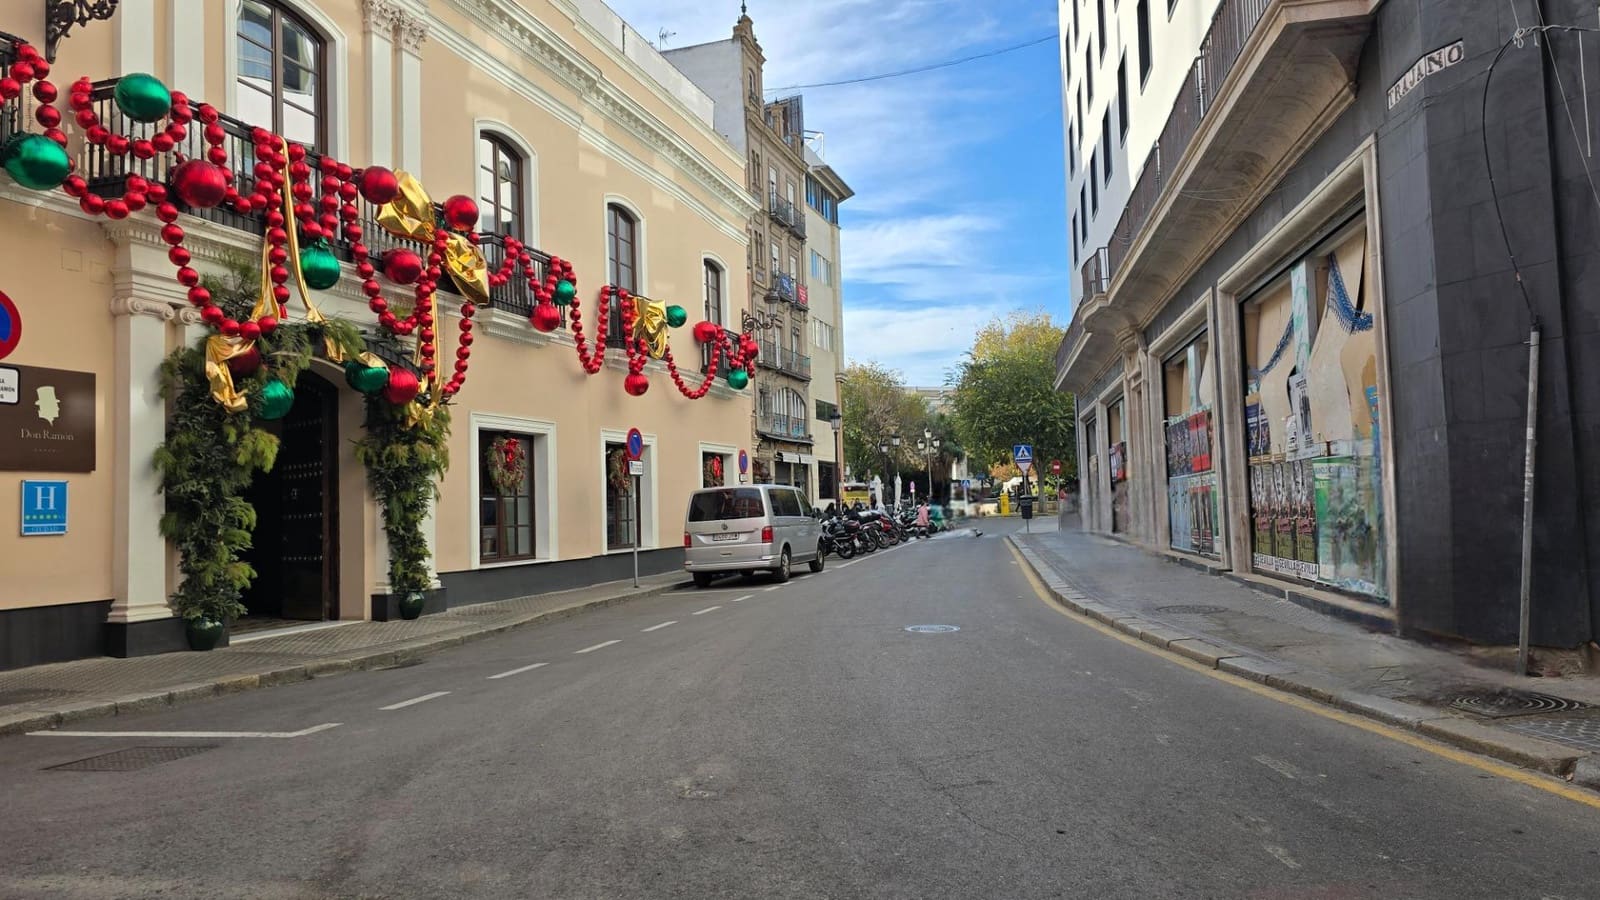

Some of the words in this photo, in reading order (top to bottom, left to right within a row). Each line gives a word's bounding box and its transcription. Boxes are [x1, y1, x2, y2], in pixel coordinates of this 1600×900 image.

[1388, 45, 1463, 106] TRAJANO
[21, 428, 42, 439] Don
[34, 486, 57, 510] H
